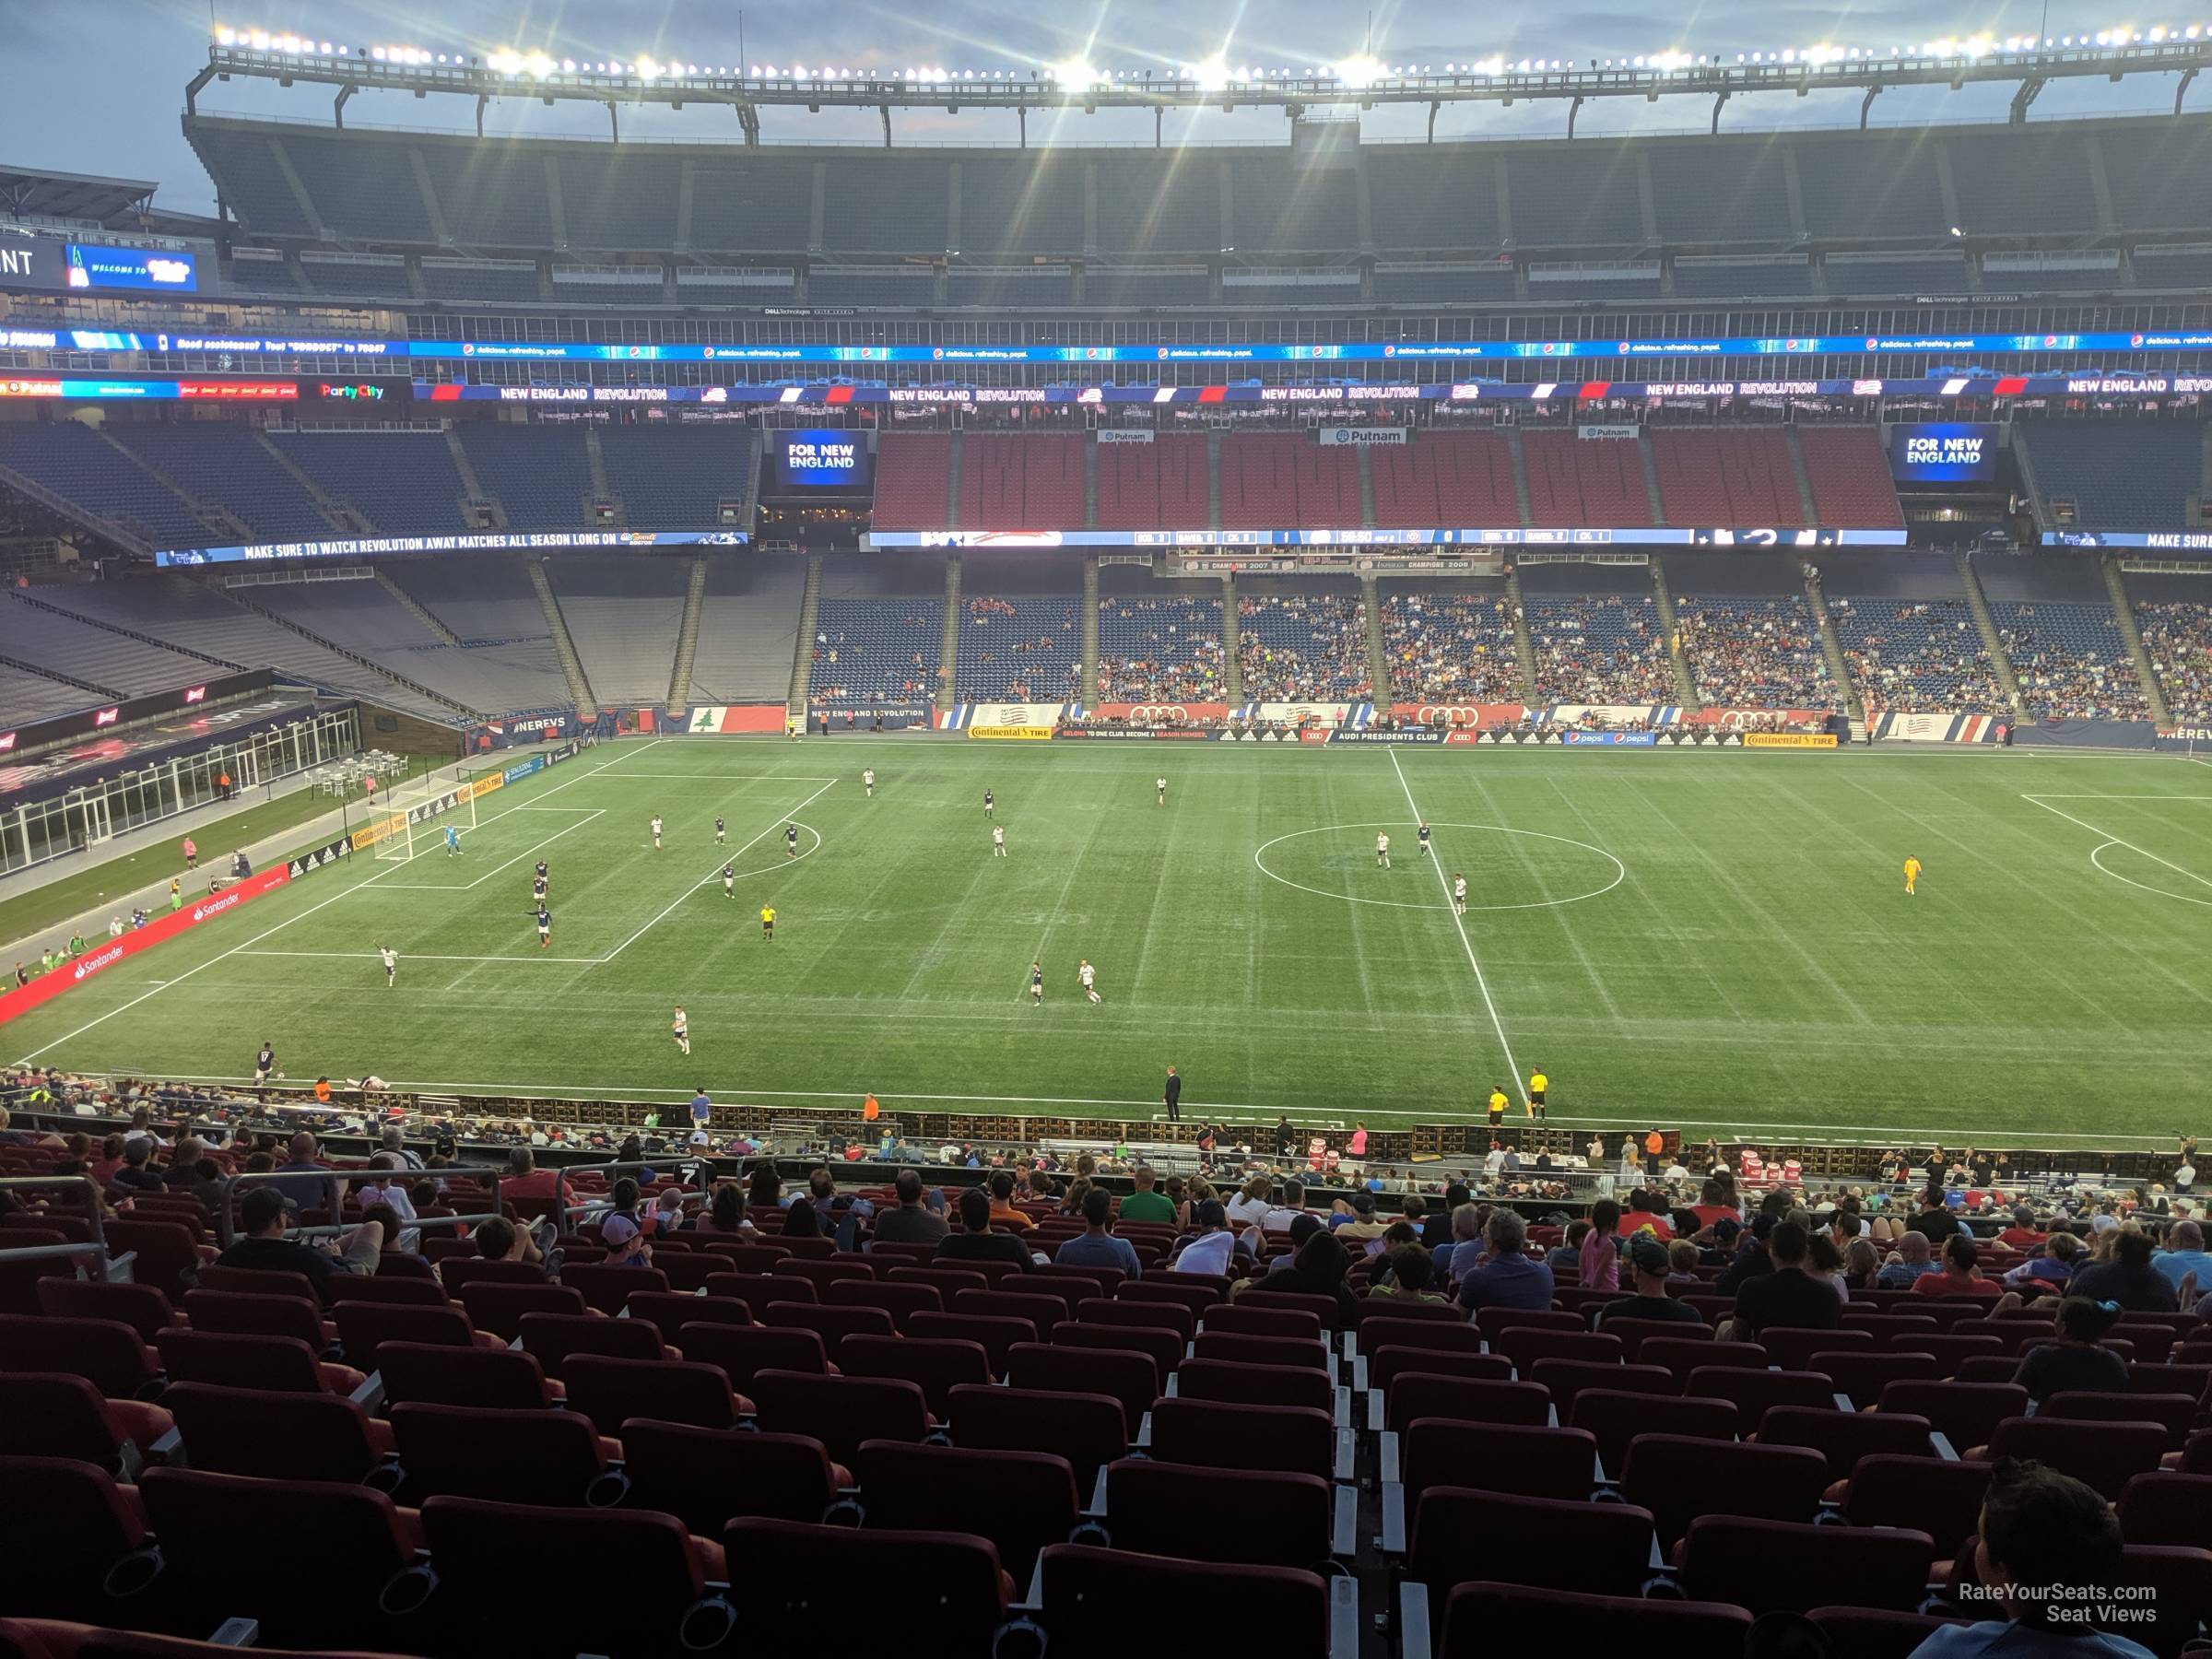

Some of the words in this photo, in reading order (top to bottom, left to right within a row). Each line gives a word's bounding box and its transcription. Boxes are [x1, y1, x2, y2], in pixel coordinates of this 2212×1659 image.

[0, 250, 32, 275] NT
[92, 265, 132, 273] WELCOME
[1646, 385, 1674, 394] NEW
[1677, 383, 1734, 394] ENGLAND
[1740, 382, 1817, 394] REVOLUTION
[2068, 380, 2100, 392] NEW
[2102, 380, 2167, 392] ENGLAND
[501, 388, 527, 400] NEW
[531, 388, 587, 400] ENGLAND
[594, 388, 667, 400] REVOLUTION
[889, 391, 914, 401] NEW
[917, 391, 970, 401] ENGLAND
[976, 390, 1045, 401] REVOLUTION
[1262, 388, 1287, 400] NEW
[1290, 388, 1342, 399] ENGLAND
[1348, 387, 1419, 398] REVOLUTION
[1351, 431, 1401, 441] Putnam
[789, 444, 816, 455] FOR
[820, 444, 853, 455] NEW
[1908, 439, 1938, 450] FOR
[1945, 439, 1983, 450] NEW
[789, 457, 853, 468] ENGLAND
[1907, 452, 1981, 463] ENGLAND
[2147, 534, 2180, 546] MAKE
[245, 544, 275, 559] MAKE
[276, 543, 302, 559] SURE
[305, 542, 318, 556] TO
[320, 540, 357, 555] WATCH
[359, 537, 422, 552] REVOLUTION
[426, 536, 455, 549] AWAY
[458, 535, 507, 548] MATCHES
[509, 535, 528, 547] ALL
[530, 534, 570, 546] SEASON
[572, 534, 600, 546] LONG
[602, 533, 617, 545] ON
[971, 726, 1021, 737] Continental
[1362, 733, 1414, 741] PRESIDENTS
[1581, 735, 1604, 743] pepsi
[1626, 735, 1649, 743] pepsi
[1747, 735, 1802, 746] Continental
[203, 893, 239, 916] Santander
[85, 946, 124, 973] Santander
[682, 1169, 695, 1184] 7
